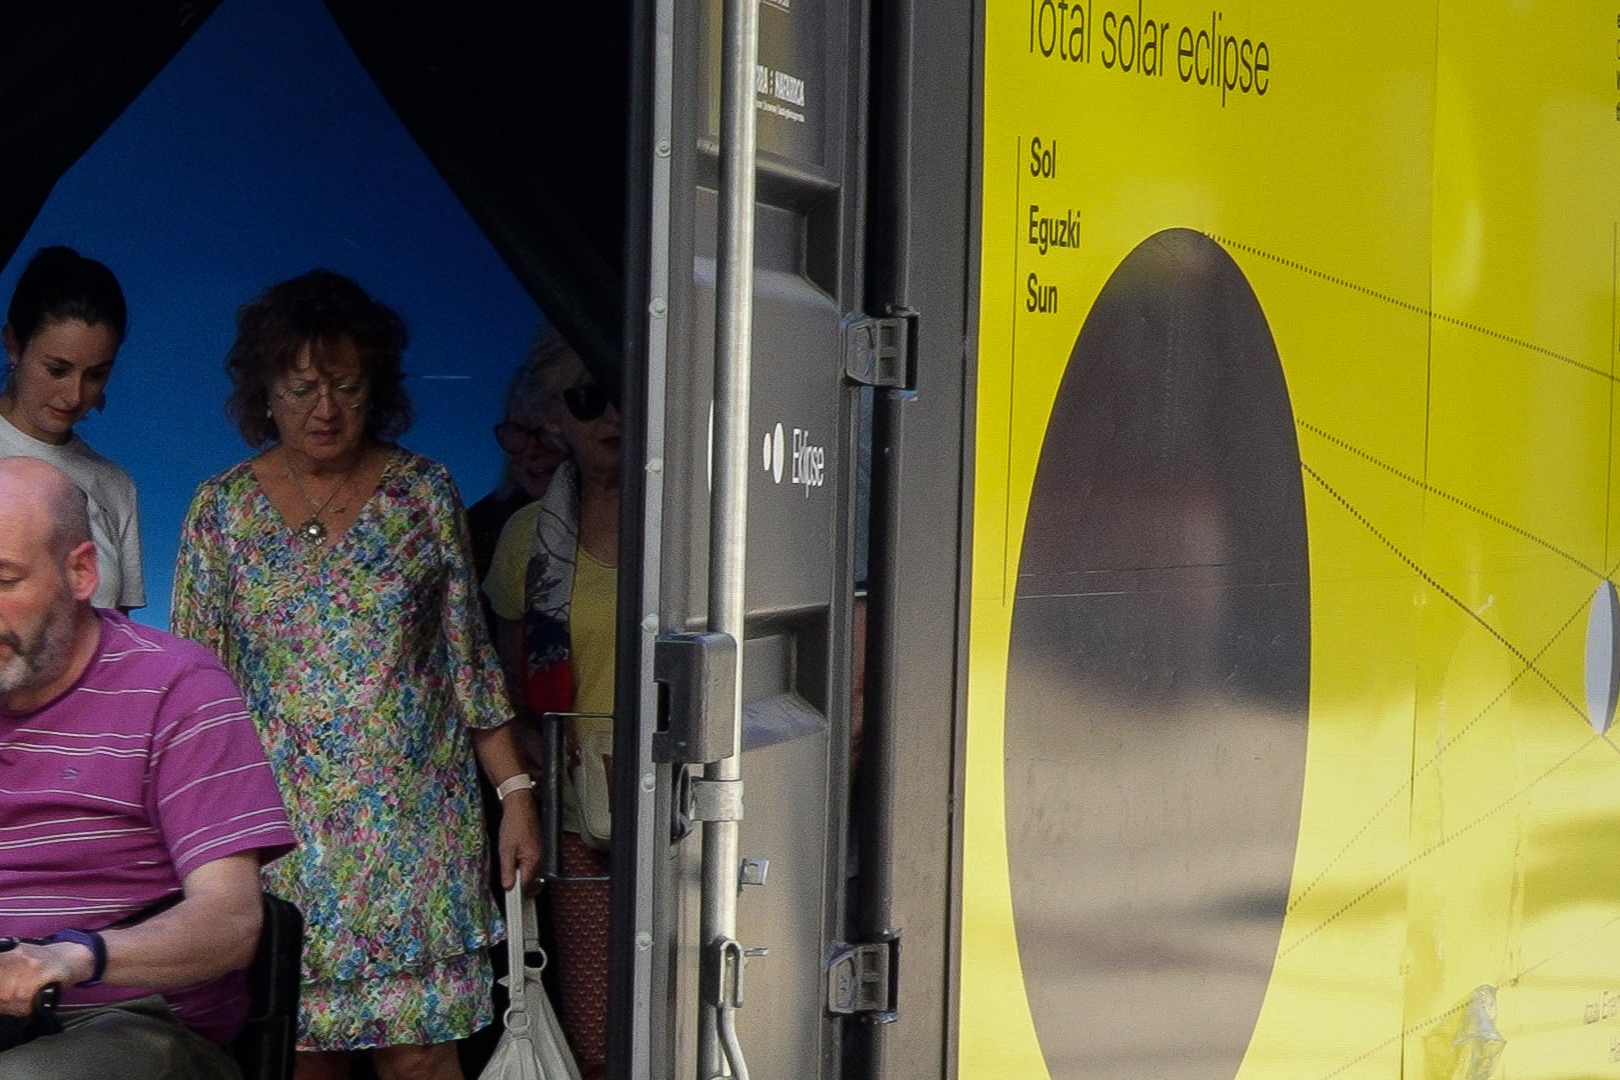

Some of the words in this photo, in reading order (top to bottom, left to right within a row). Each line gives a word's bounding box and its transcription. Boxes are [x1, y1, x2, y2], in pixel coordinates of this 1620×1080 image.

[1101, 0, 1170, 77] solar
[1177, 10, 1270, 108] eclipse
[1030, 136, 1057, 179] Sol
[1029, 204, 1081, 256] Eguzki
[1026, 272, 1058, 314] Sun
